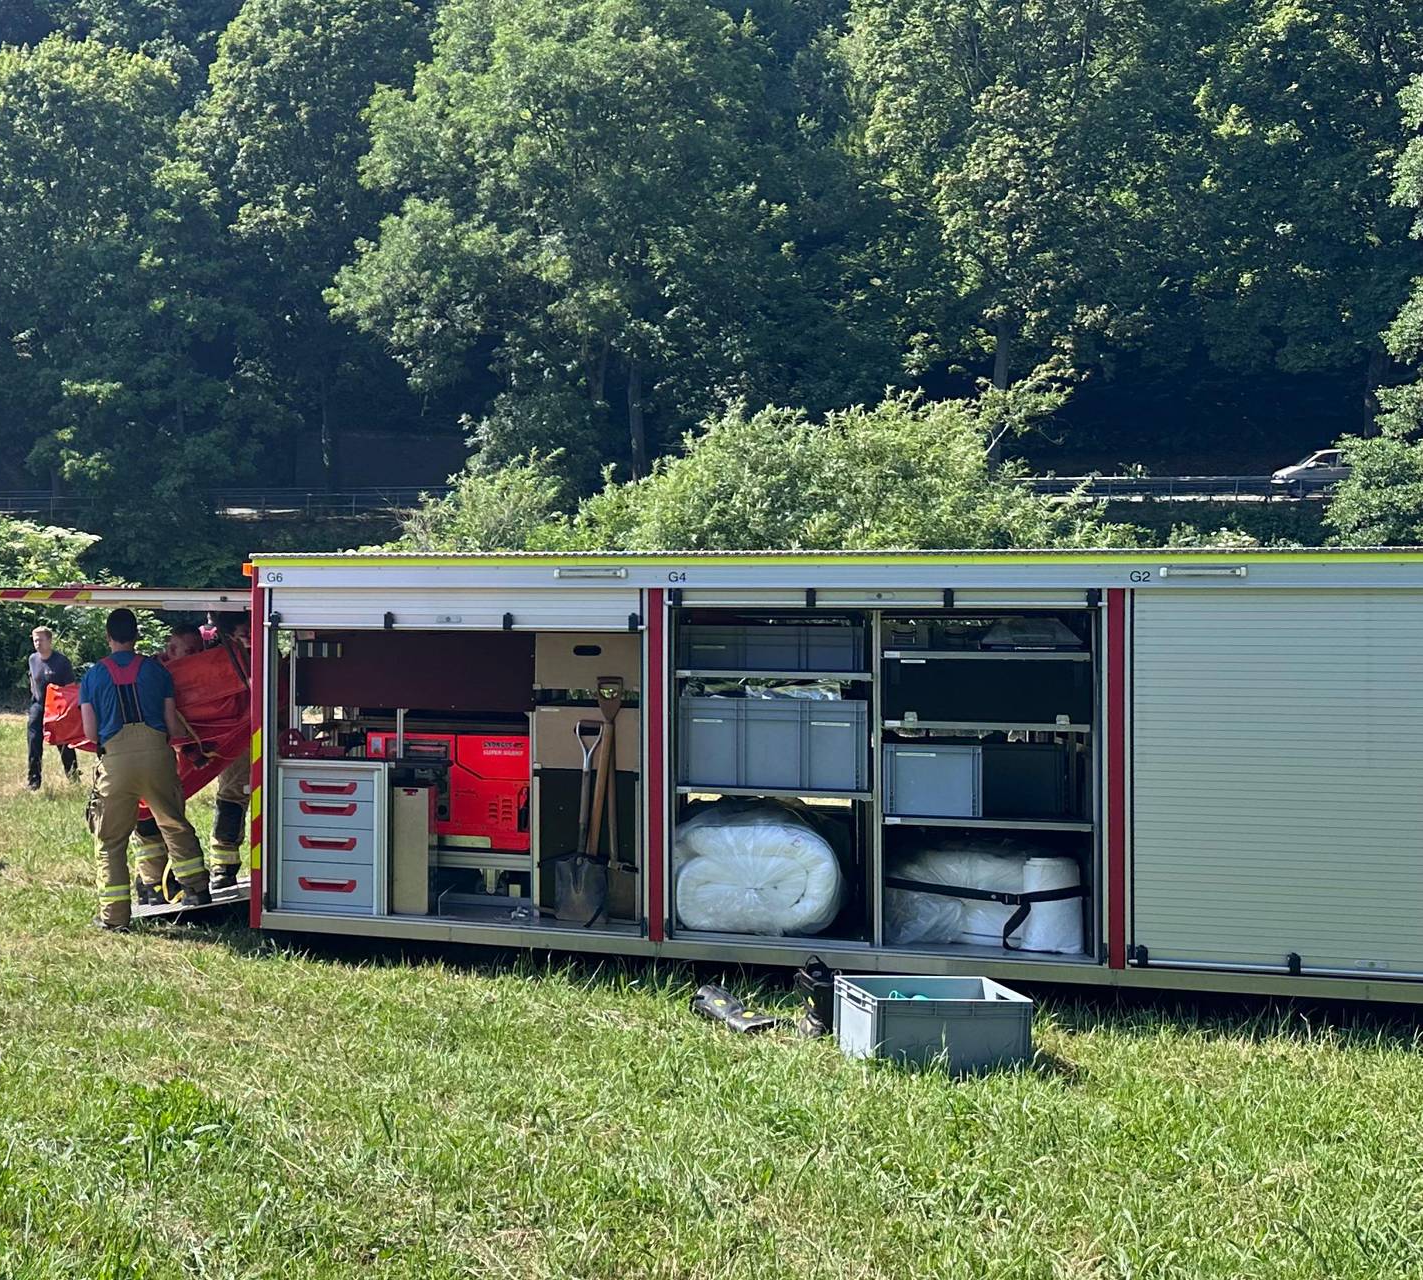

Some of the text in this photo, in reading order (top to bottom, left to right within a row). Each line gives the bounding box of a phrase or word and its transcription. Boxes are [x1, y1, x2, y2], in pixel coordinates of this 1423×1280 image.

[267, 571, 283, 583] G6
[668, 571, 686, 583] G4
[1130, 570, 1151, 583] G2
